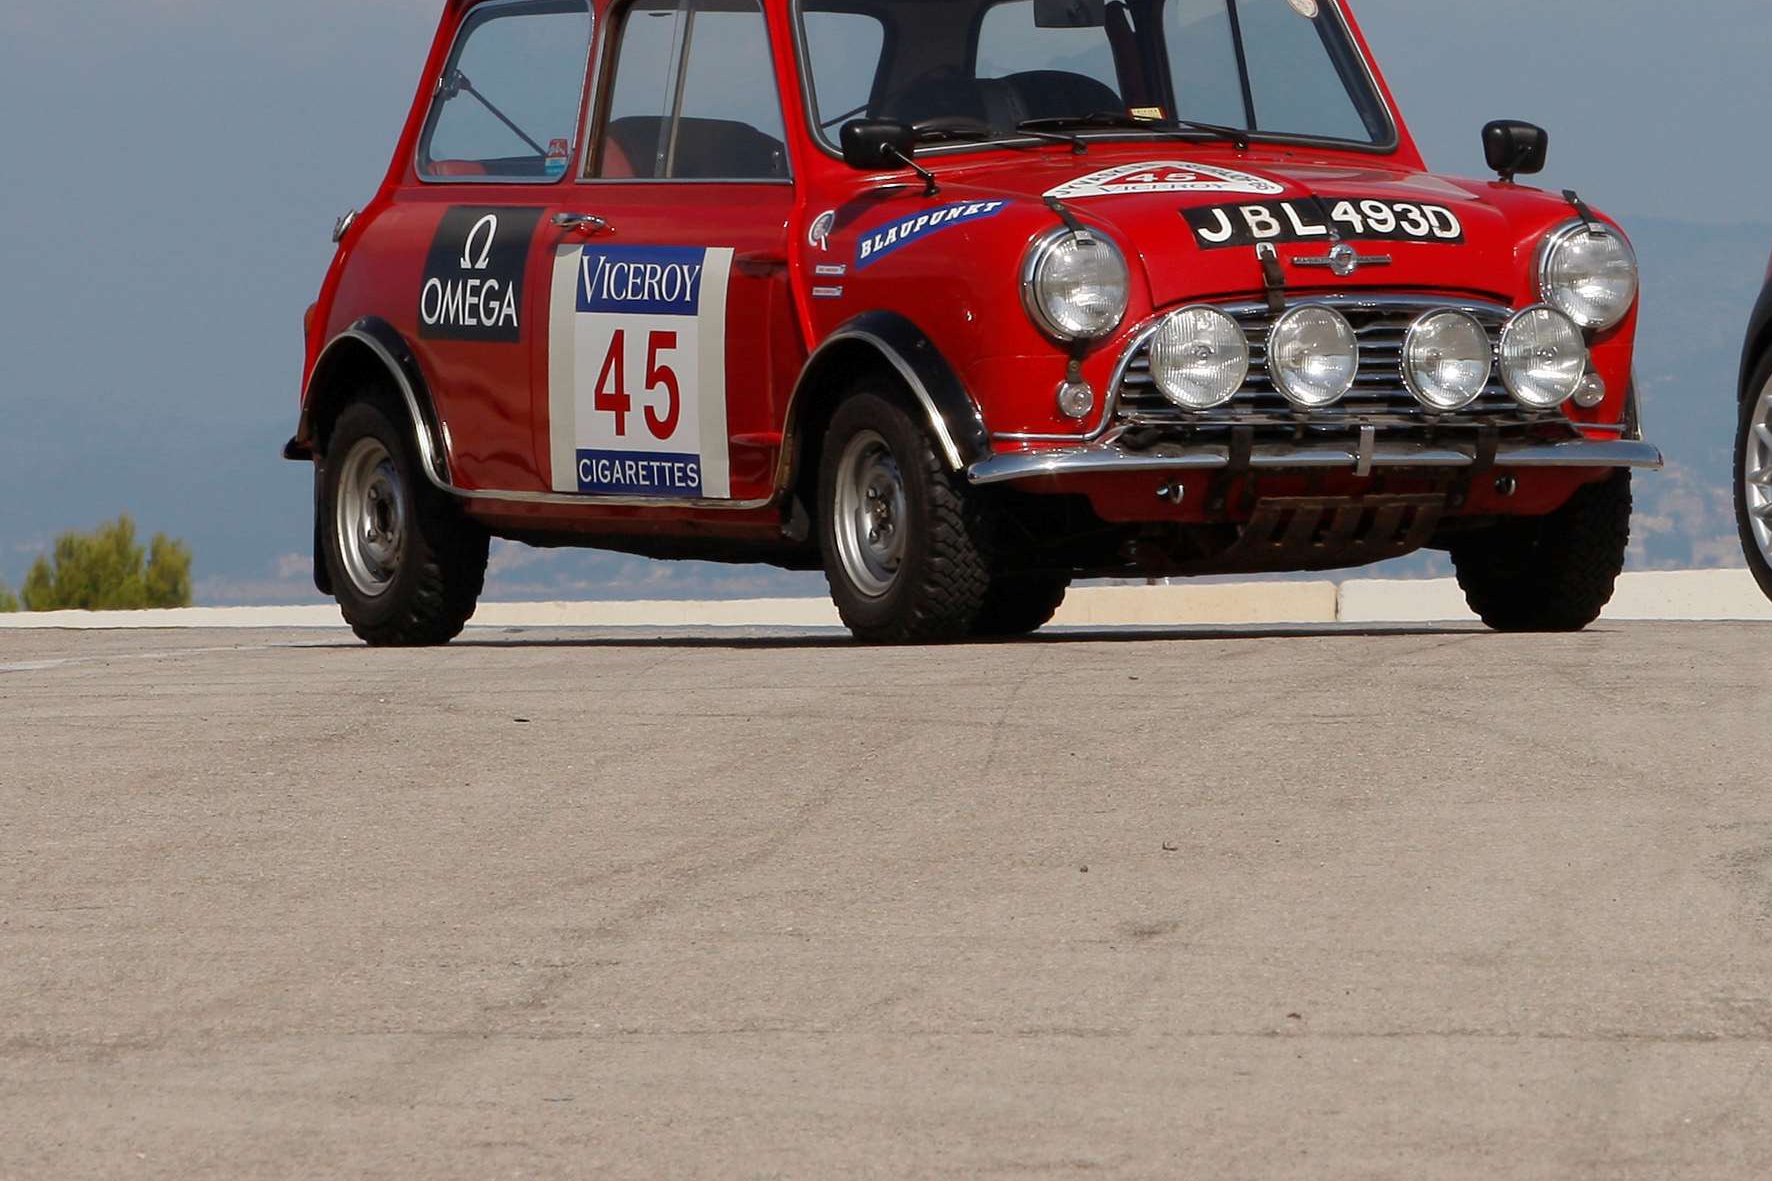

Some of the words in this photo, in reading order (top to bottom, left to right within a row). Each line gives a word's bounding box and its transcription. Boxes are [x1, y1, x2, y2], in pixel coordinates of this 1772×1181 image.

[1100, 183, 1224, 193] VICEROY
[1125, 172, 1198, 182] 45
[859, 201, 1003, 259] BLAUPUNKT
[420, 277, 519, 328] OMEGA
[582, 255, 701, 304] VICEROY
[594, 329, 681, 440] 45
[578, 458, 700, 488] CIGARETTES
